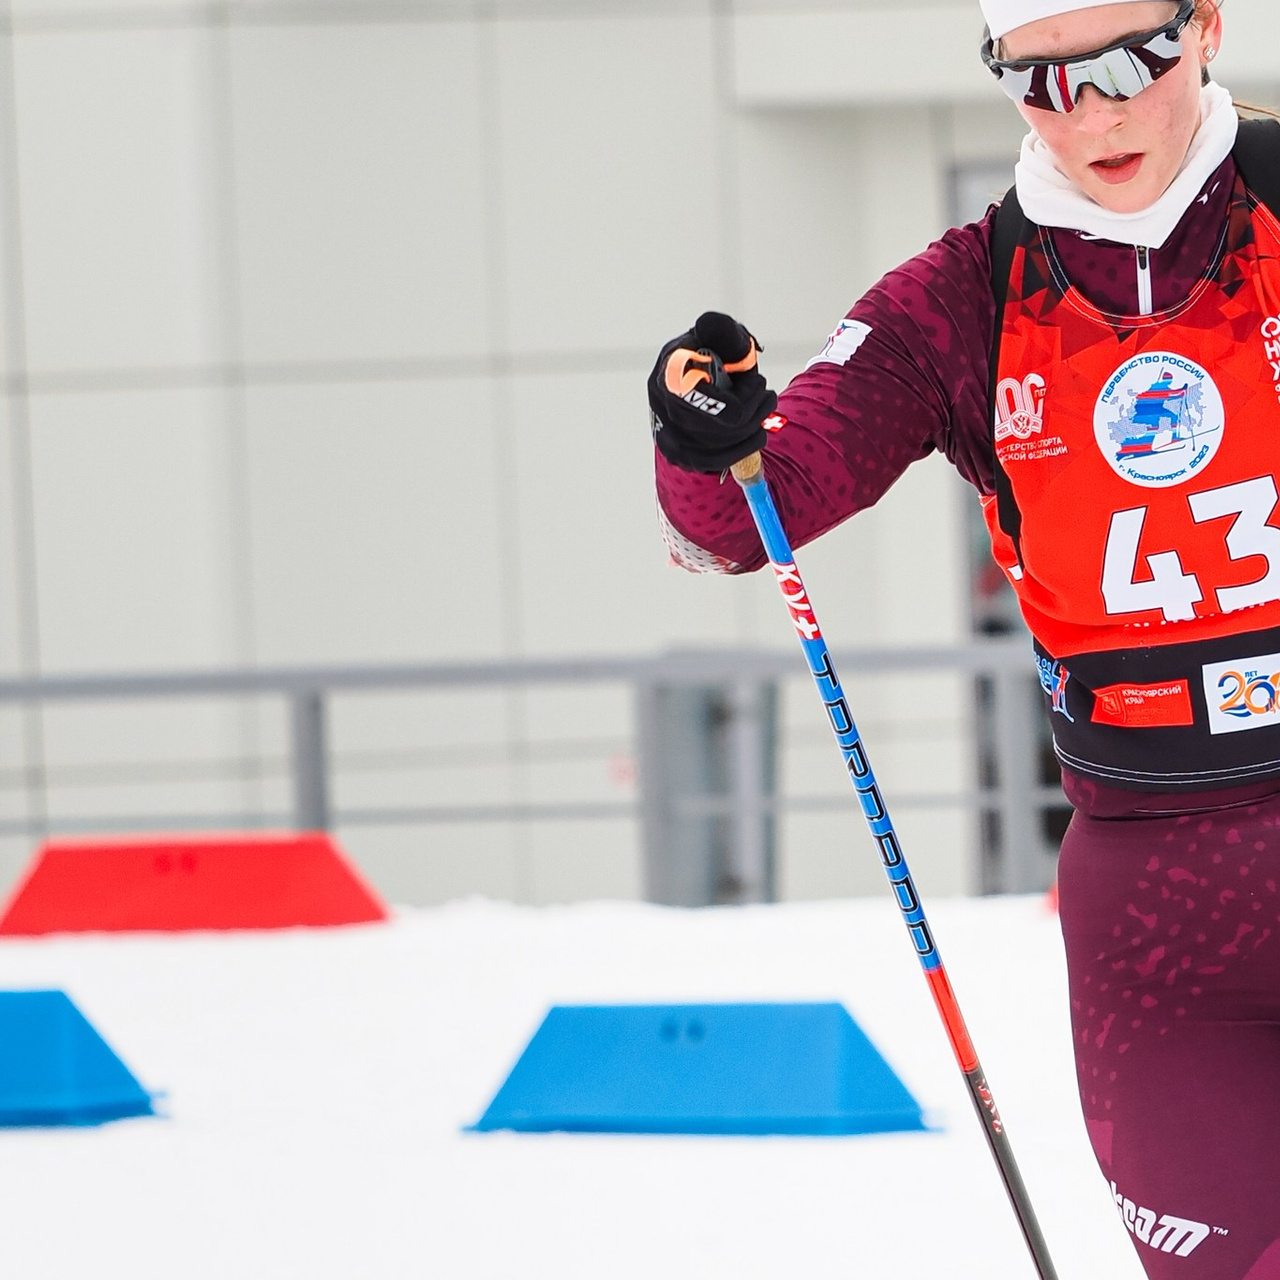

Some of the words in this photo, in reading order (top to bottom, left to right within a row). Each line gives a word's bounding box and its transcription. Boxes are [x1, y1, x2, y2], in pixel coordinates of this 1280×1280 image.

[1100, 355, 1160, 404] ПЕРВЕНСТВО
[1161, 355, 1205, 381] РОССИИ
[1127, 467, 1188, 482] Красноярск
[1188, 444, 1211, 469] 2023
[1217, 670, 1276, 718] 20
[812, 649, 936, 957] TORNADO
